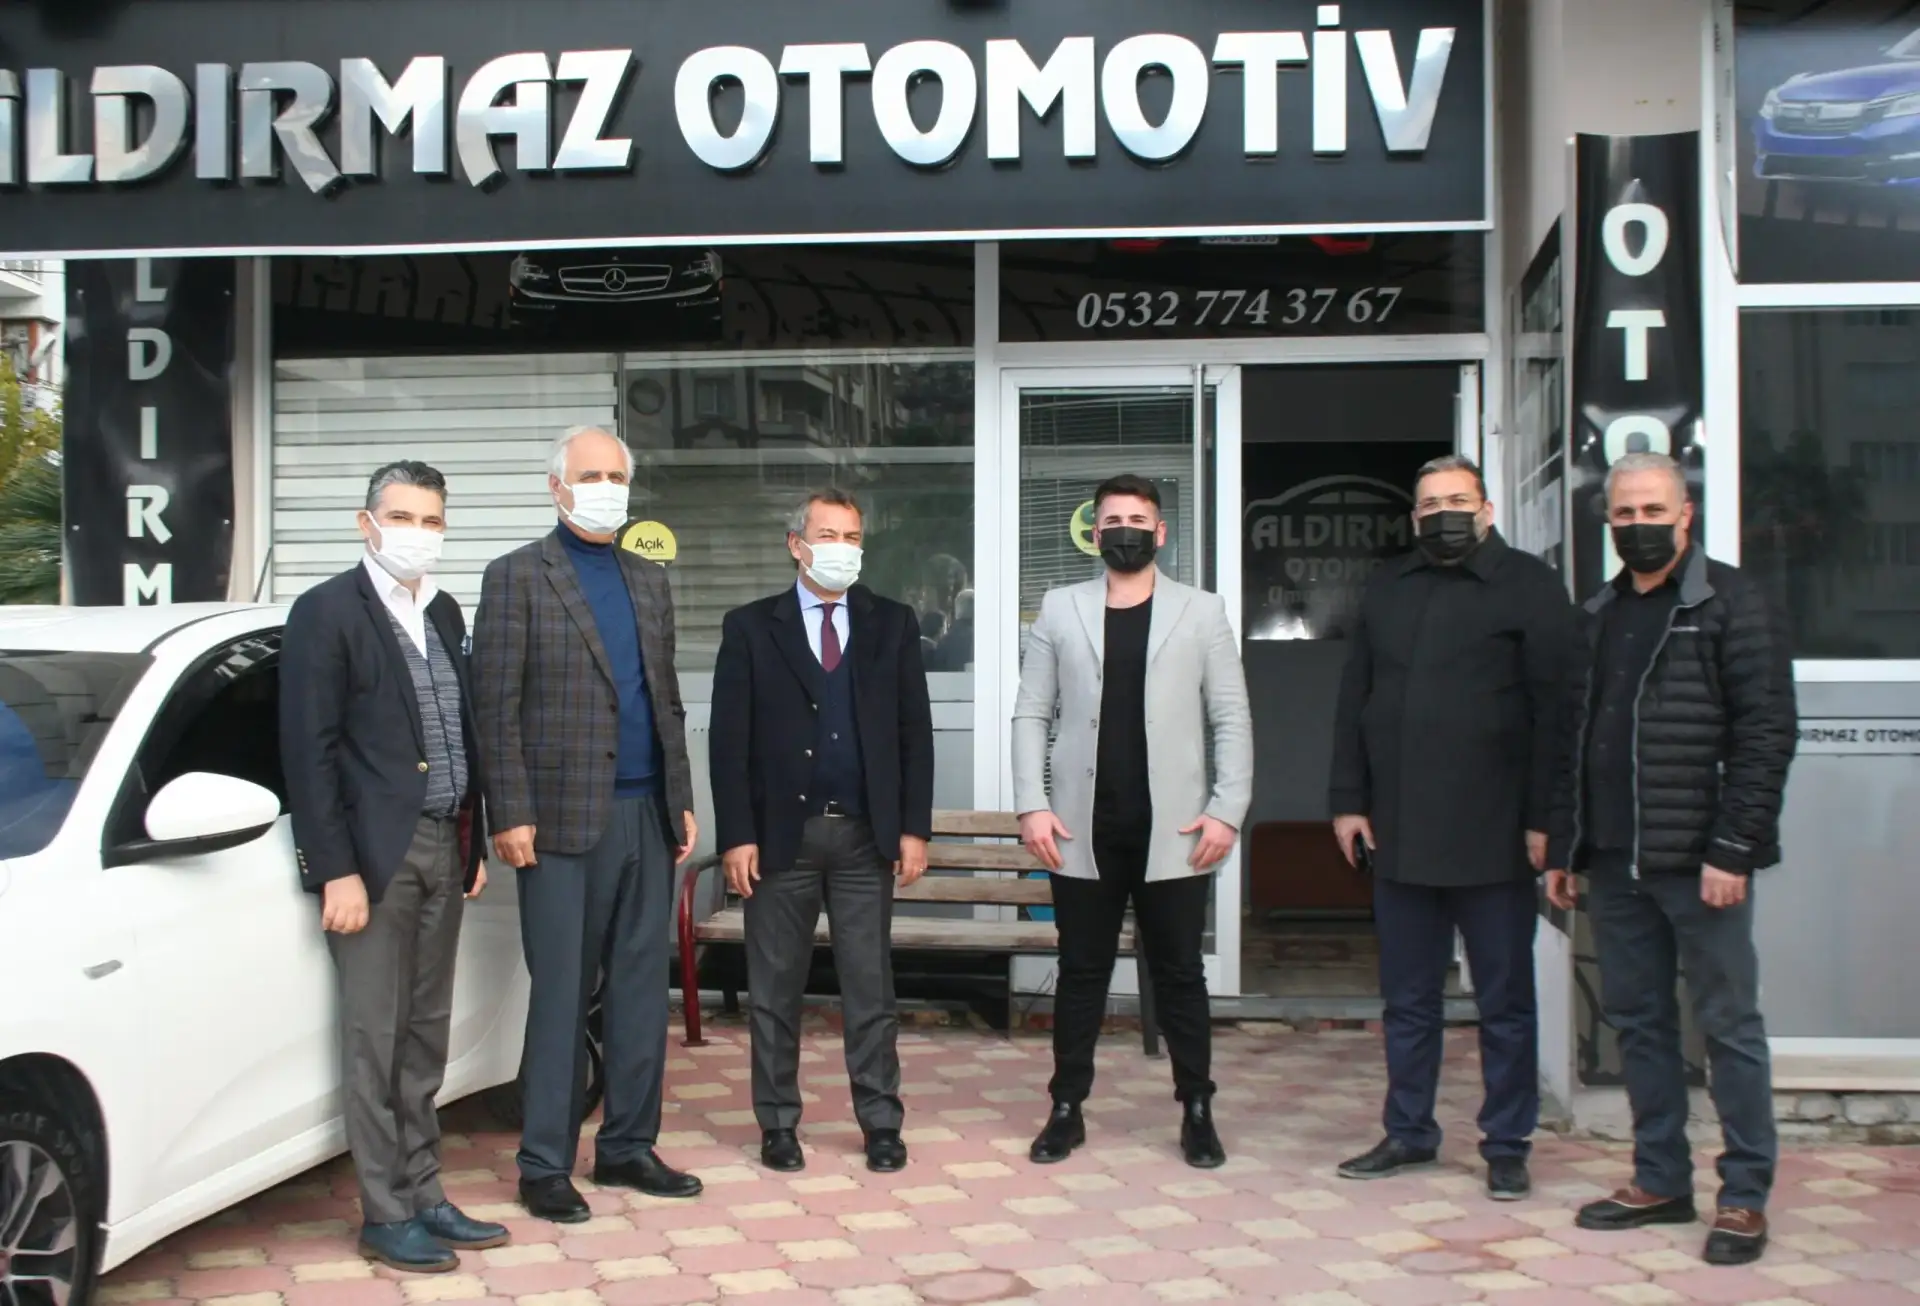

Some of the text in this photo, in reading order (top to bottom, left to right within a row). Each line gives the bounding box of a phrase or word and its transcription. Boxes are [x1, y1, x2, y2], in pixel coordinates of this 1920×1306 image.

[674, 5, 1456, 170] OTOMOTİV
[1076, 287, 1402, 328] 0532 774 37 67
[634, 537, 664, 552] Açık
